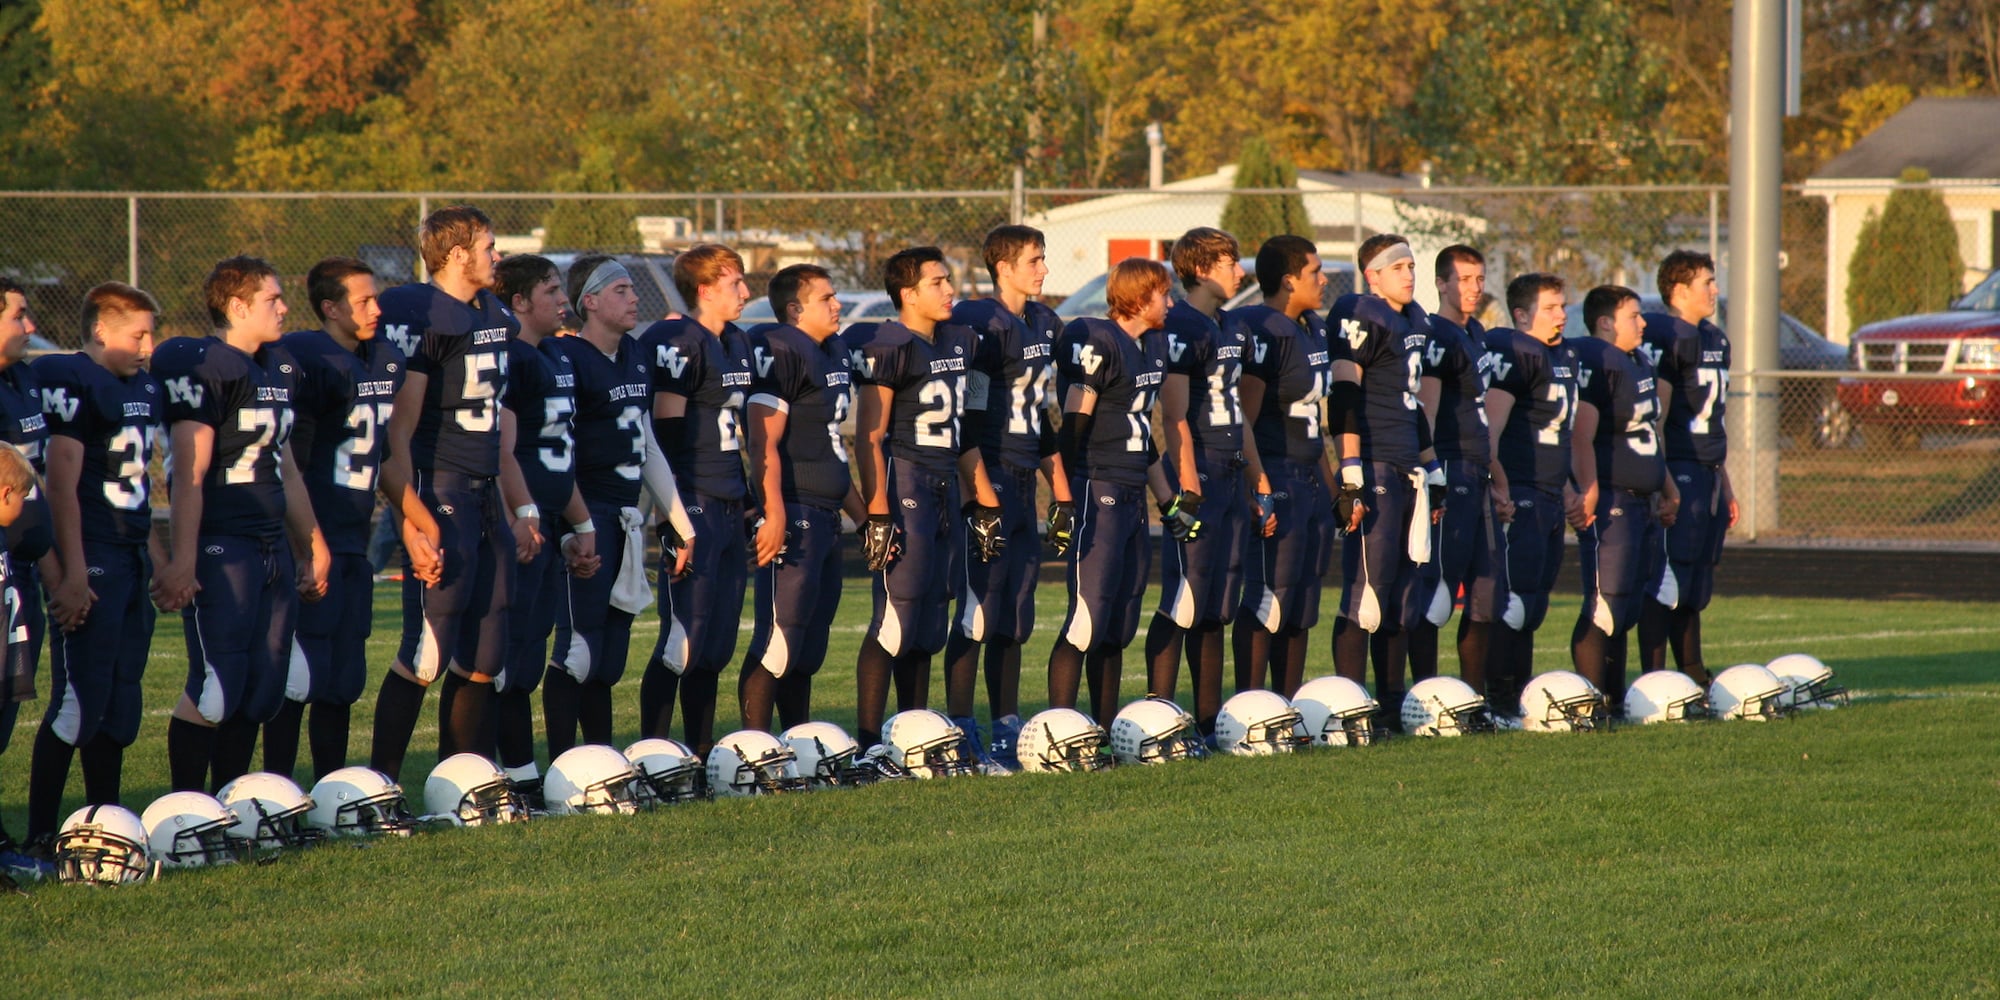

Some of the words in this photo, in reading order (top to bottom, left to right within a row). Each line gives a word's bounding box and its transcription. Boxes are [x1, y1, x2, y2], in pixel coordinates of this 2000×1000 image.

[385, 324, 421, 357] MV
[1253, 335, 1268, 364] V
[1338, 318, 1368, 350] MV
[656, 345, 688, 379] MV
[1072, 343, 1103, 375] MV
[1577, 361, 1592, 388] V
[42, 387, 79, 422] MV
[165, 376, 203, 408] MV
[456, 351, 508, 432] 5
[1288, 370, 1332, 438] 4
[1690, 368, 1729, 434] 7
[1127, 390, 1156, 452] 1
[1538, 383, 1579, 445] 7
[1625, 396, 1660, 456] 5
[538, 396, 575, 472] 5
